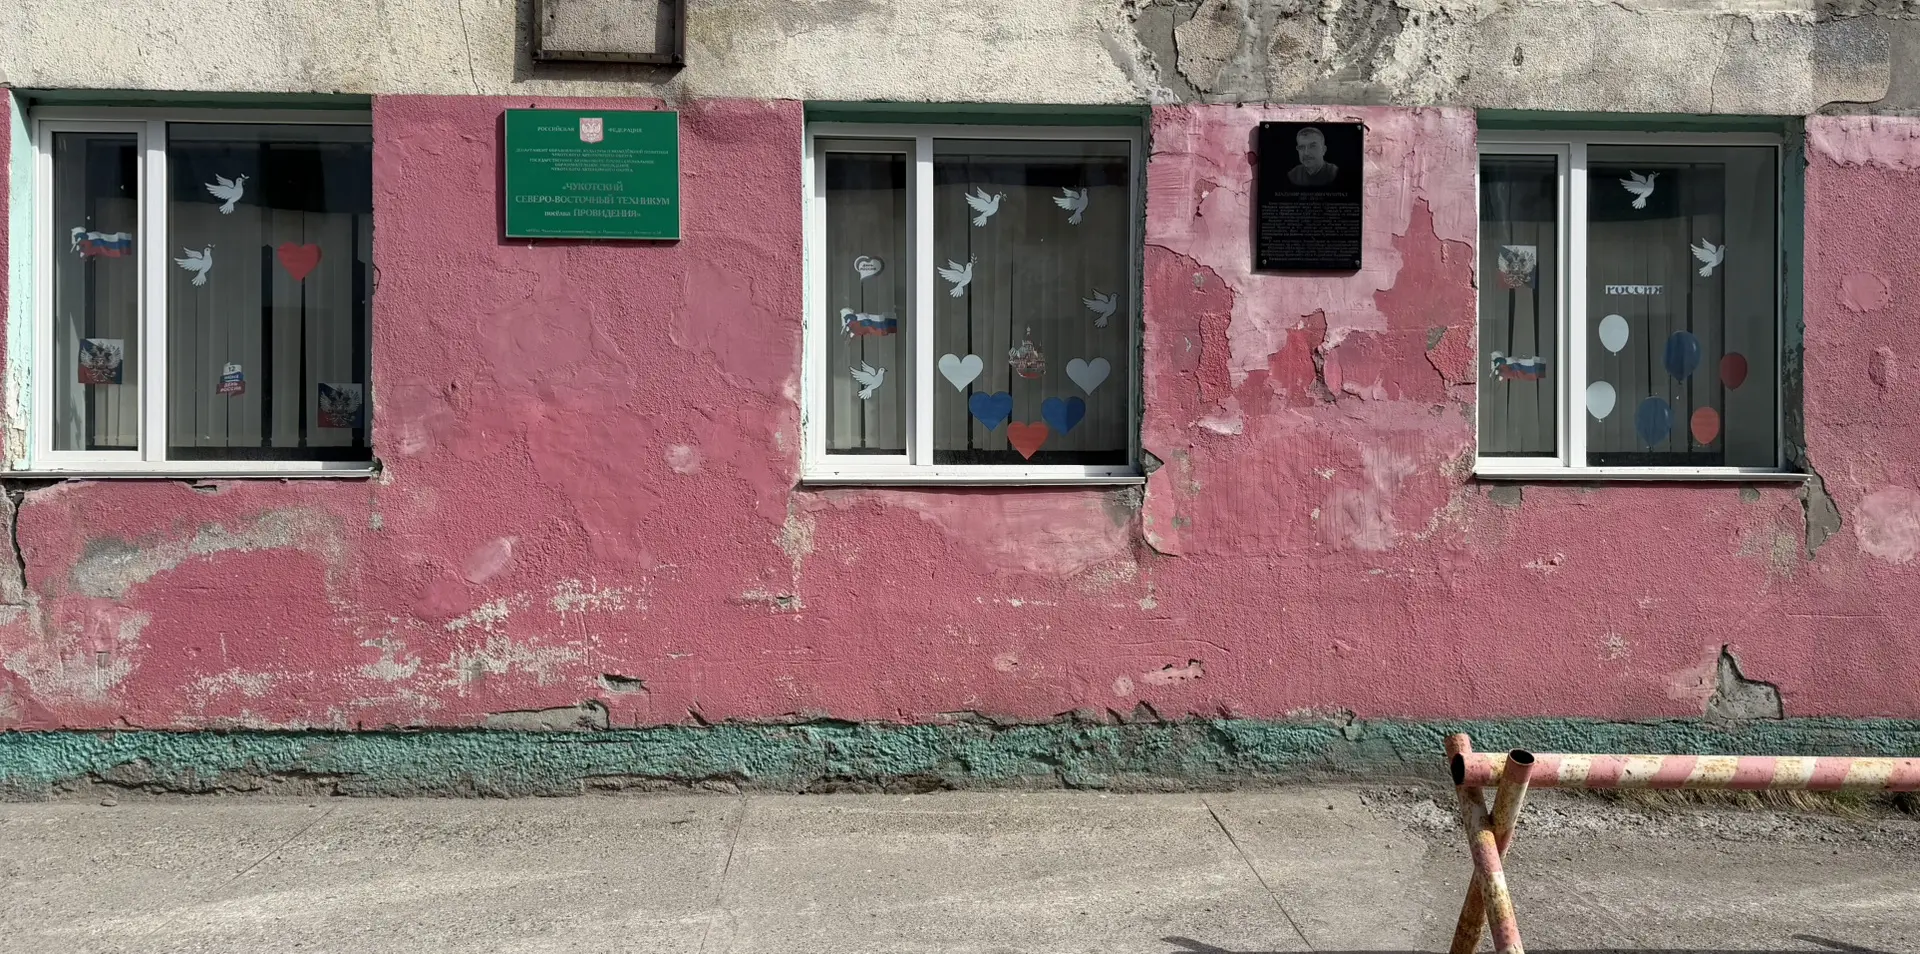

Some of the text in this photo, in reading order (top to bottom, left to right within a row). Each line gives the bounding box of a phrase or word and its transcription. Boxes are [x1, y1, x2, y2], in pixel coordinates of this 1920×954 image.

[537, 125, 575, 133] РОССИЙСКАЯ
[515, 193, 670, 206] СЕВЕРО-ВОСТОЧНЫЙ ТЕХНИКУМ
